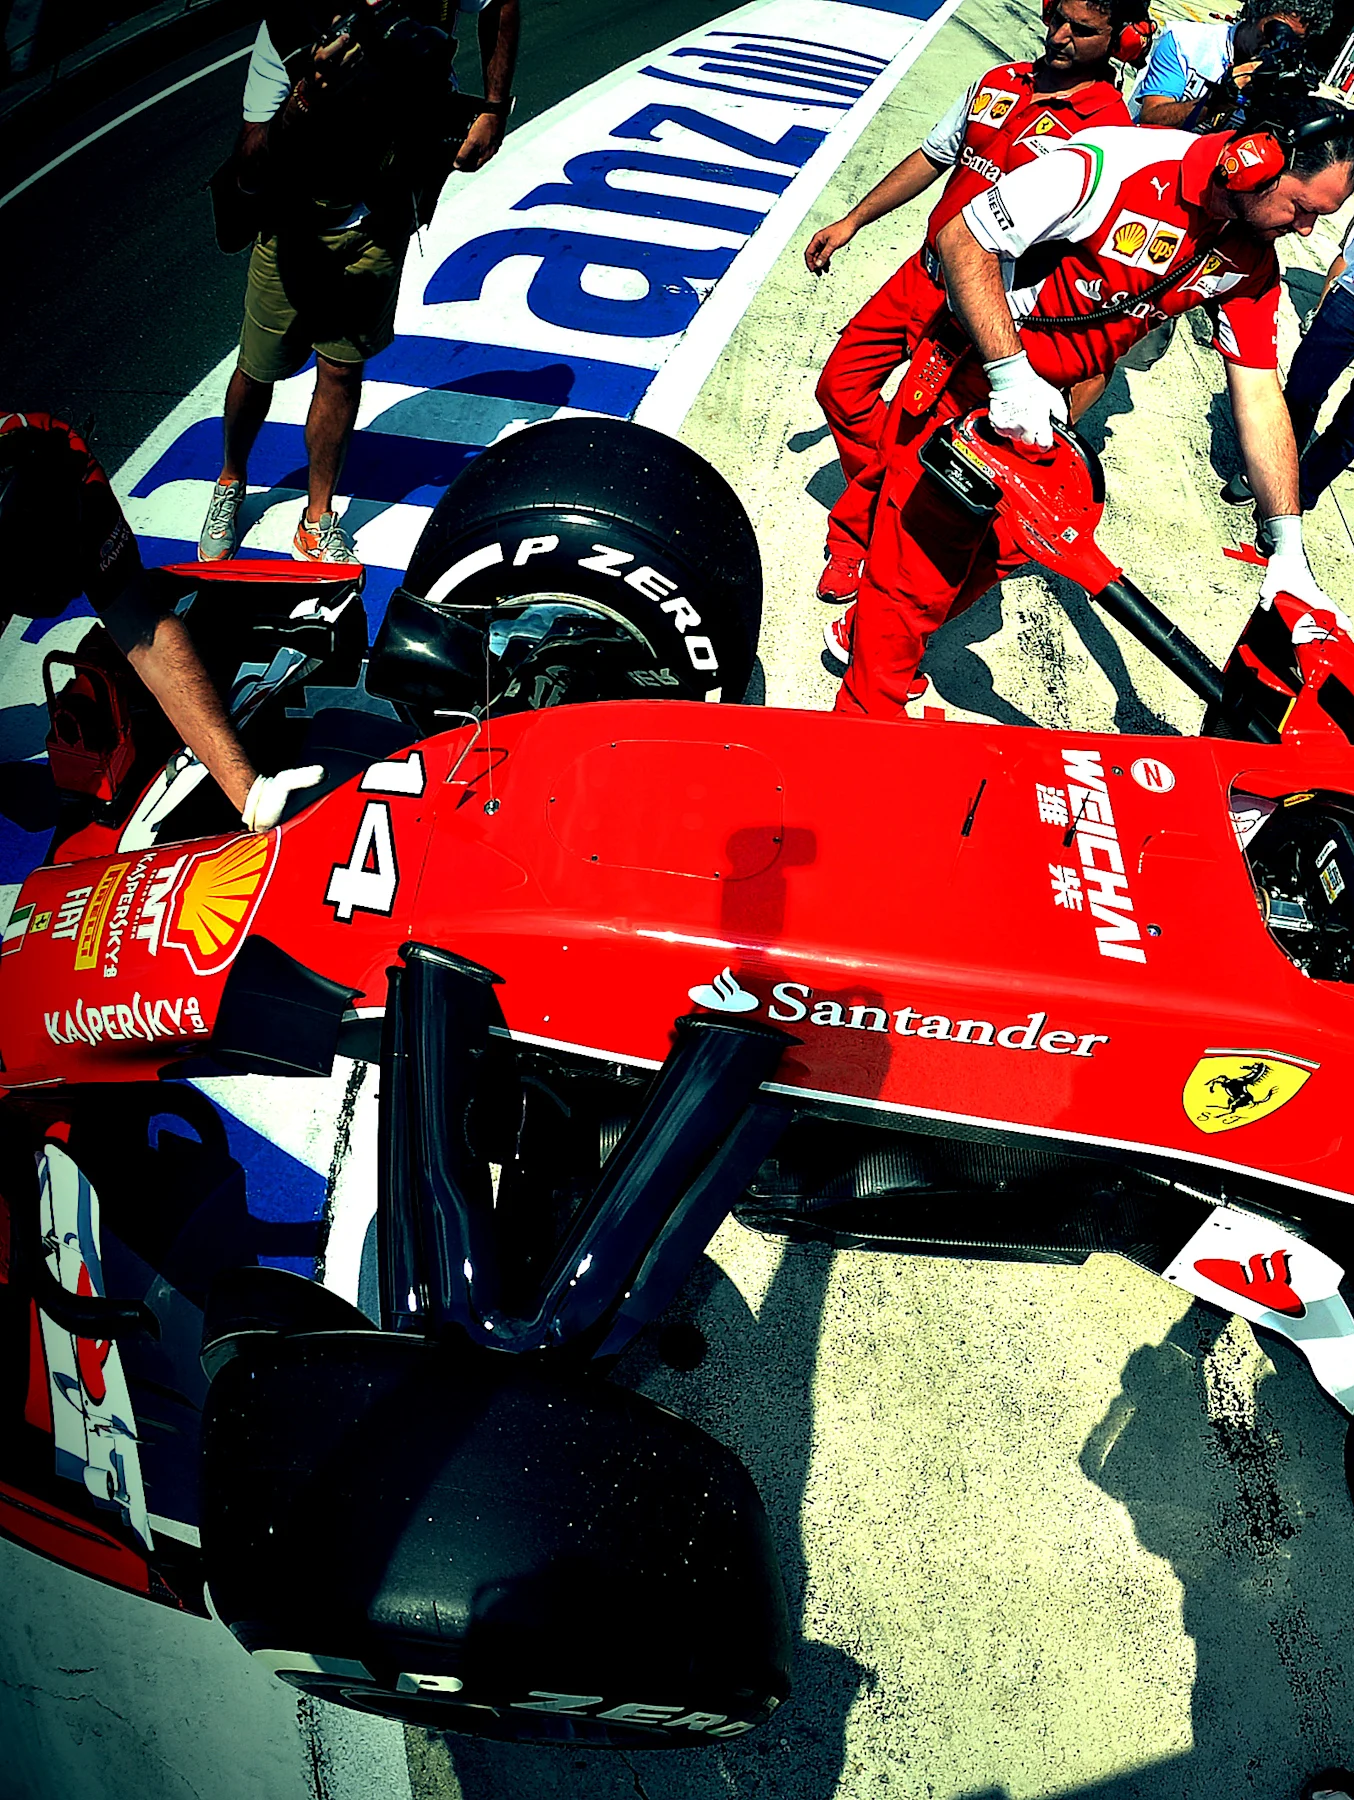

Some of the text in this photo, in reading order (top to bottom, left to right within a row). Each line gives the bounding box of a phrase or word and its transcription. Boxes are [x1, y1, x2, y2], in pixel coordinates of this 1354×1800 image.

[960, 146, 1001, 184] Santa
[1149, 238, 1175, 260] ups
[512, 533, 719, 671] P ZERO
[1142, 762, 1163, 788] N
[323, 749, 428, 926] 14
[1060, 748, 1148, 964] WEICHAI
[51, 885, 93, 941] FIAT
[104, 852, 158, 964] KASPERSKY
[136, 853, 190, 957] TNT
[43, 991, 188, 1047] KASPERSKY
[766, 980, 1112, 1060] Santander
[395, 1671, 756, 1738] P ZERO
